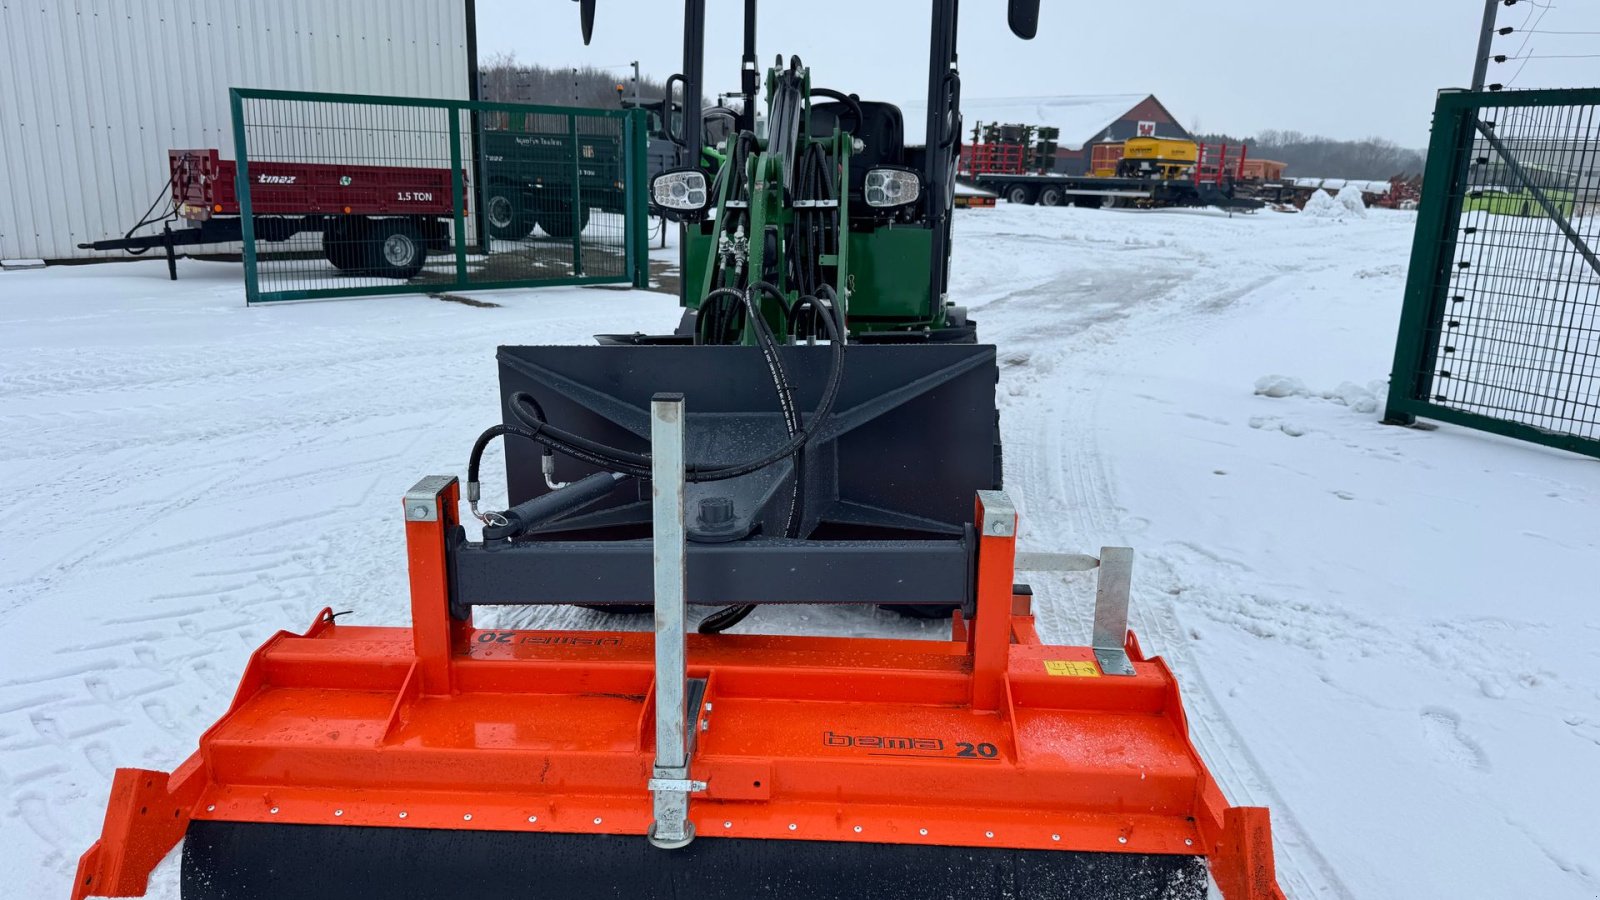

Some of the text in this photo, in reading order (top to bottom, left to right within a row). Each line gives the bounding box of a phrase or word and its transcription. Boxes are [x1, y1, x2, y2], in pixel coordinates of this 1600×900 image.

[413, 192, 432, 202] TON
[478, 632, 515, 644] 20
[823, 731, 998, 758] bema 20
